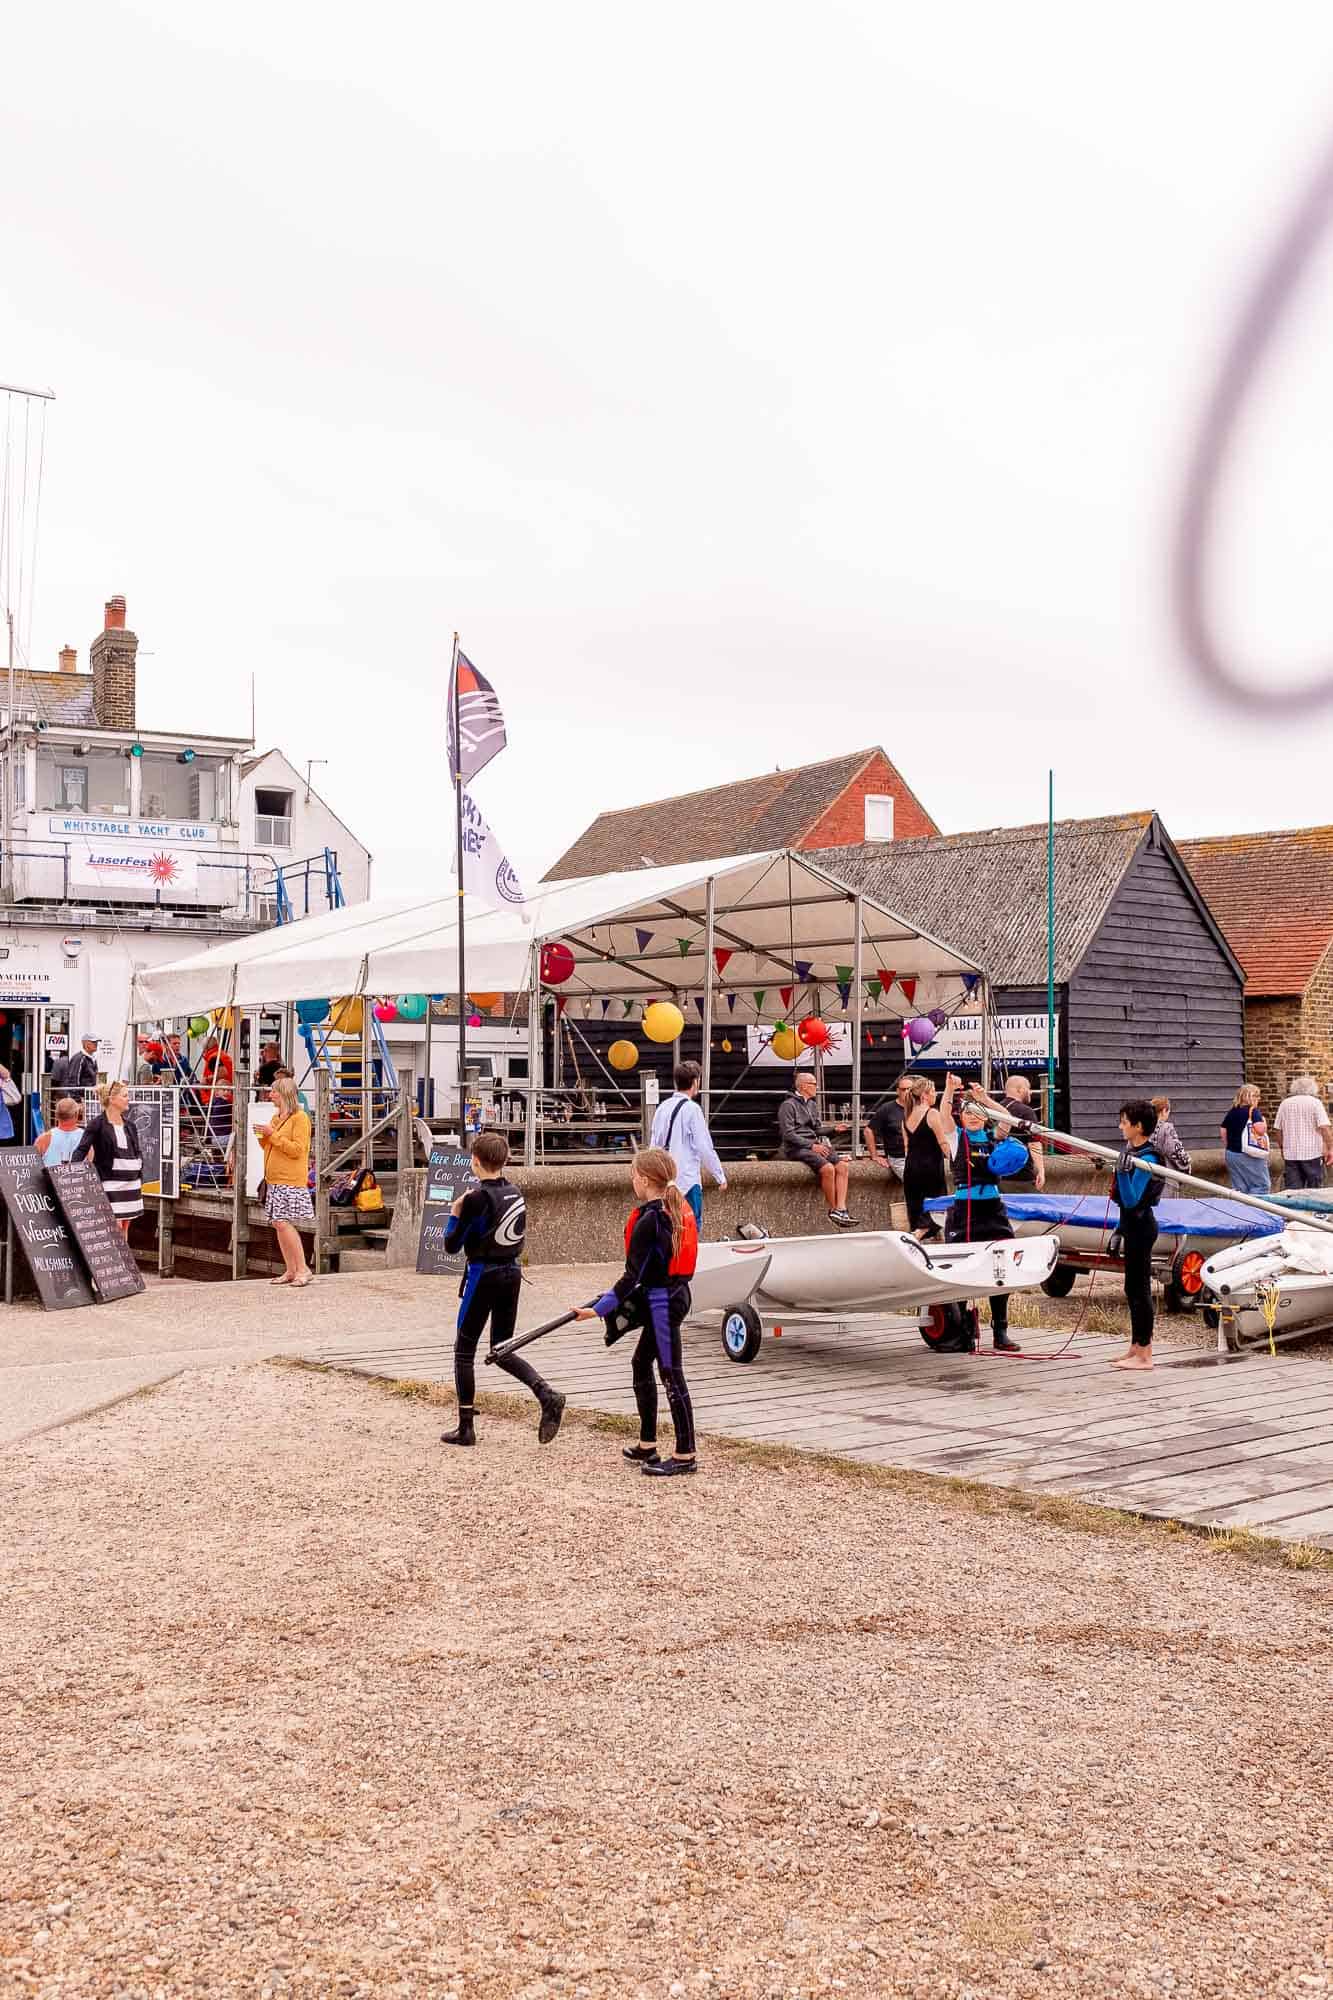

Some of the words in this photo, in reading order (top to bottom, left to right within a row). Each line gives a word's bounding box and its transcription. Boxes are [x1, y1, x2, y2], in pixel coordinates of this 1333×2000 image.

[63, 820, 130, 834] WHITSTABLE
[137, 824, 170, 837] YACHT
[179, 828, 206, 838] CLUB
[88, 854, 154, 867] LaserFest
[944, 1018, 980, 1031] TABLE
[992, 1017, 1022, 1030] ACHT
[48, 1035, 66, 1046] RYA
[5, 1154, 38, 1168] CHOCOLATE
[14, 1192, 56, 1214] PUBLIC
[33, 1255, 74, 1272] MILKSHAKES
